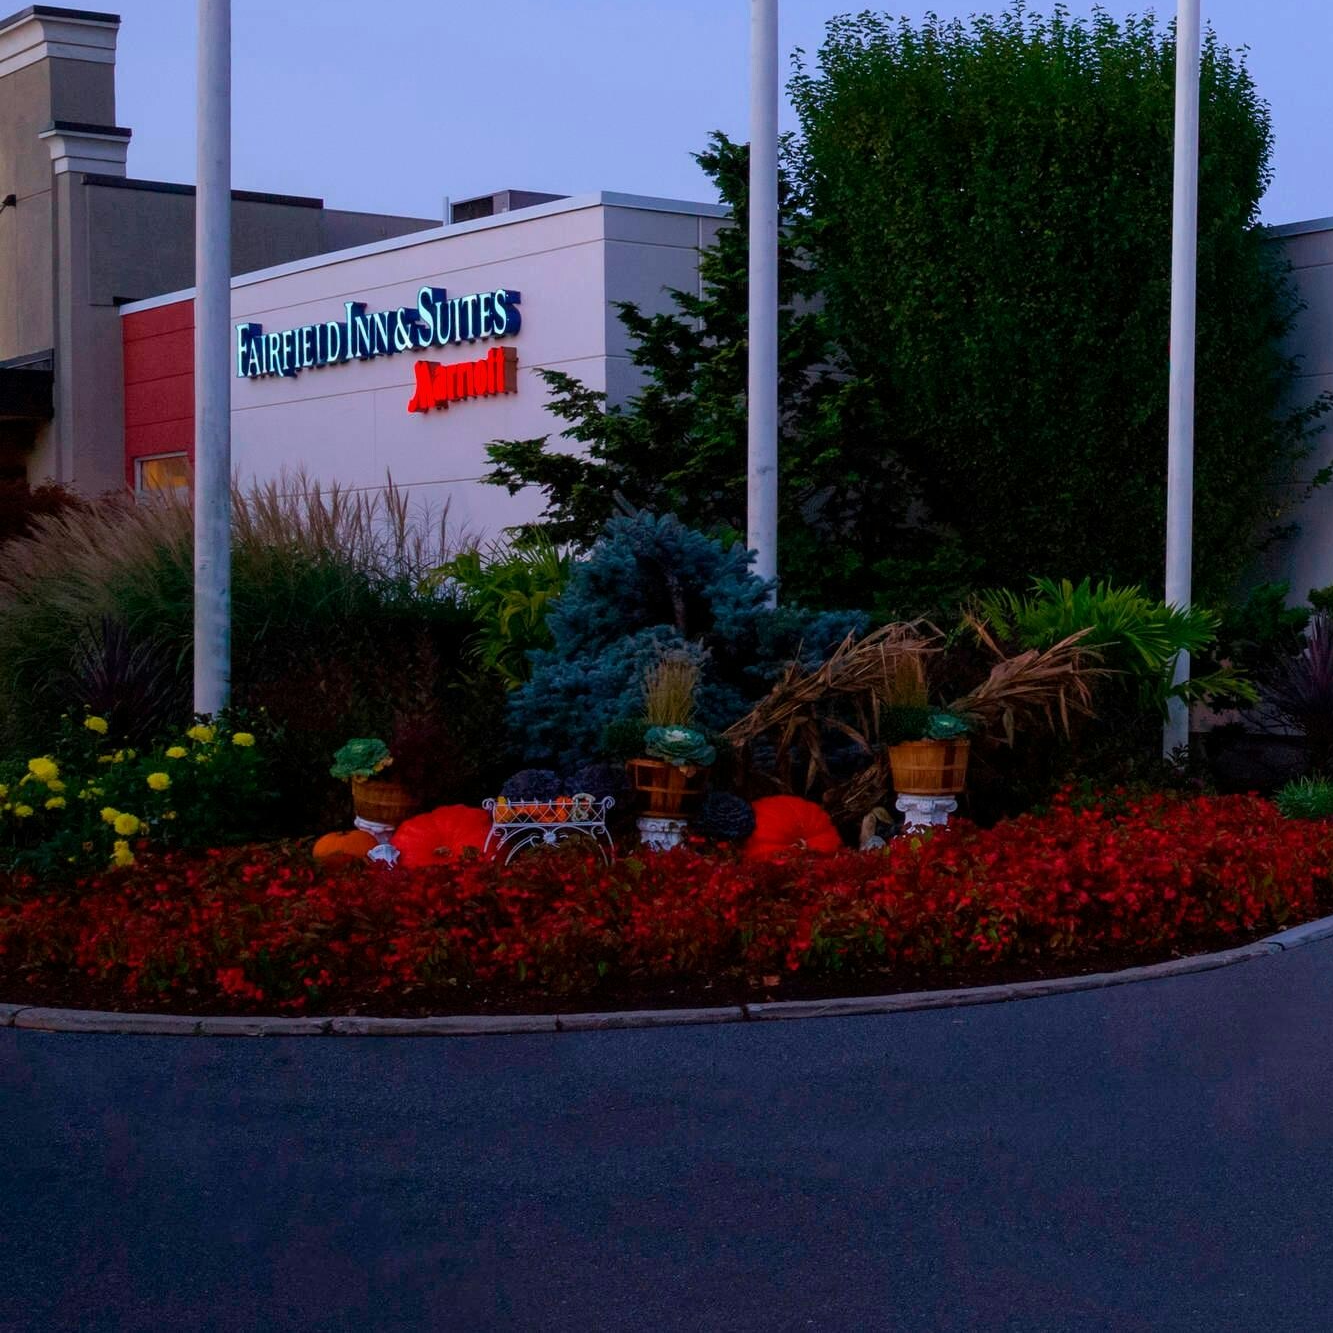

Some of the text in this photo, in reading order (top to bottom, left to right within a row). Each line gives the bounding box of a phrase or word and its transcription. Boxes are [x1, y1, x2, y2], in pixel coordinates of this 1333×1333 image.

[236, 286, 508, 378] FAIRFIELD INN & SUITES
